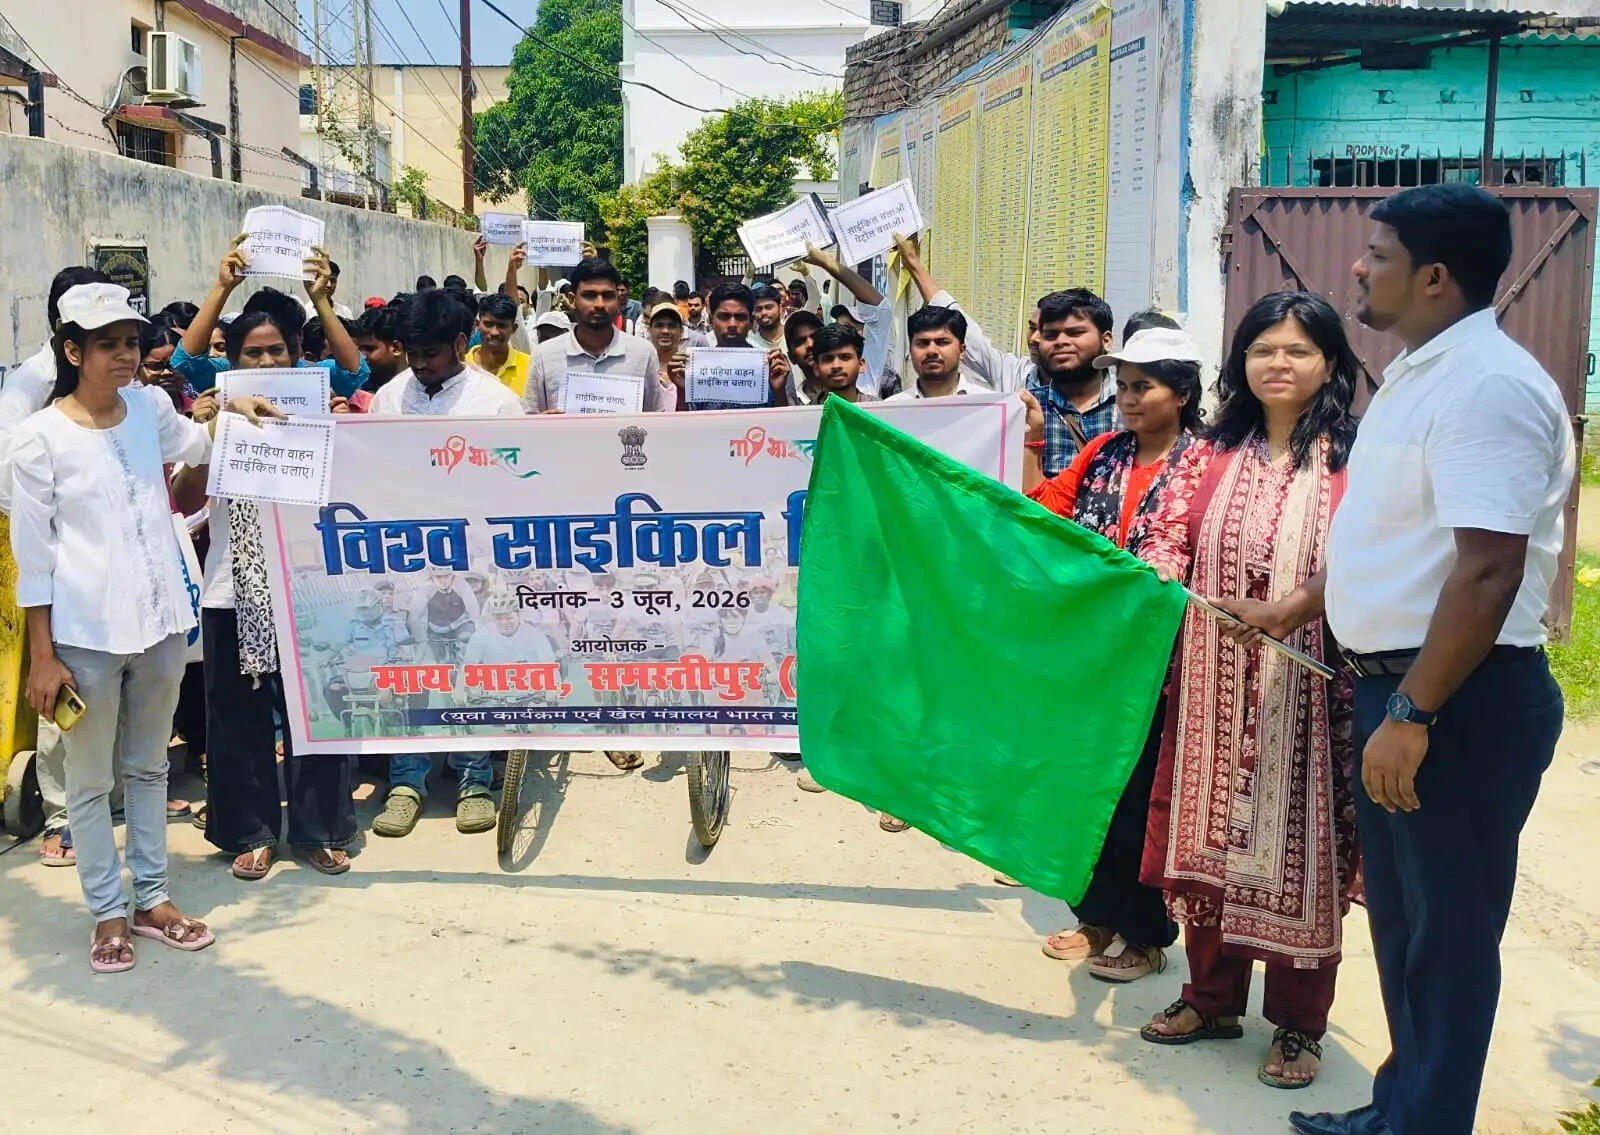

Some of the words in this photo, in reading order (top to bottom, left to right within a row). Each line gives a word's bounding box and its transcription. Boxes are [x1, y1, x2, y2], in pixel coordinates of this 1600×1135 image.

[1346, 144, 1378, 156] ROOM
[734, 367, 755, 378] वाहन
[235, 440, 249, 454] दो
[251, 442, 285, 459] पहिया
[288, 448, 314, 462] वाहन
[229, 458, 277, 474] साईकिल
[313, 502, 470, 576] विश्व
[485, 492, 765, 574] साइकिल
[610, 590, 624, 608] 3
[632, 590, 681, 615] जून,
[692, 590, 751, 608] 2026
[571, 634, 647, 653] आयोजक
[370, 664, 455, 694] माय
[464, 663, 573, 699] भारत,
[583, 654, 765, 701] समस्तीपुर
[441, 711, 485, 725] (युवा
[493, 708, 568, 721] कार्यक्रम
[574, 708, 600, 723] एवं
[608, 708, 646, 720] खेल
[652, 707, 718, 721] मंत्रालय
[726, 710, 774, 721] भारत
